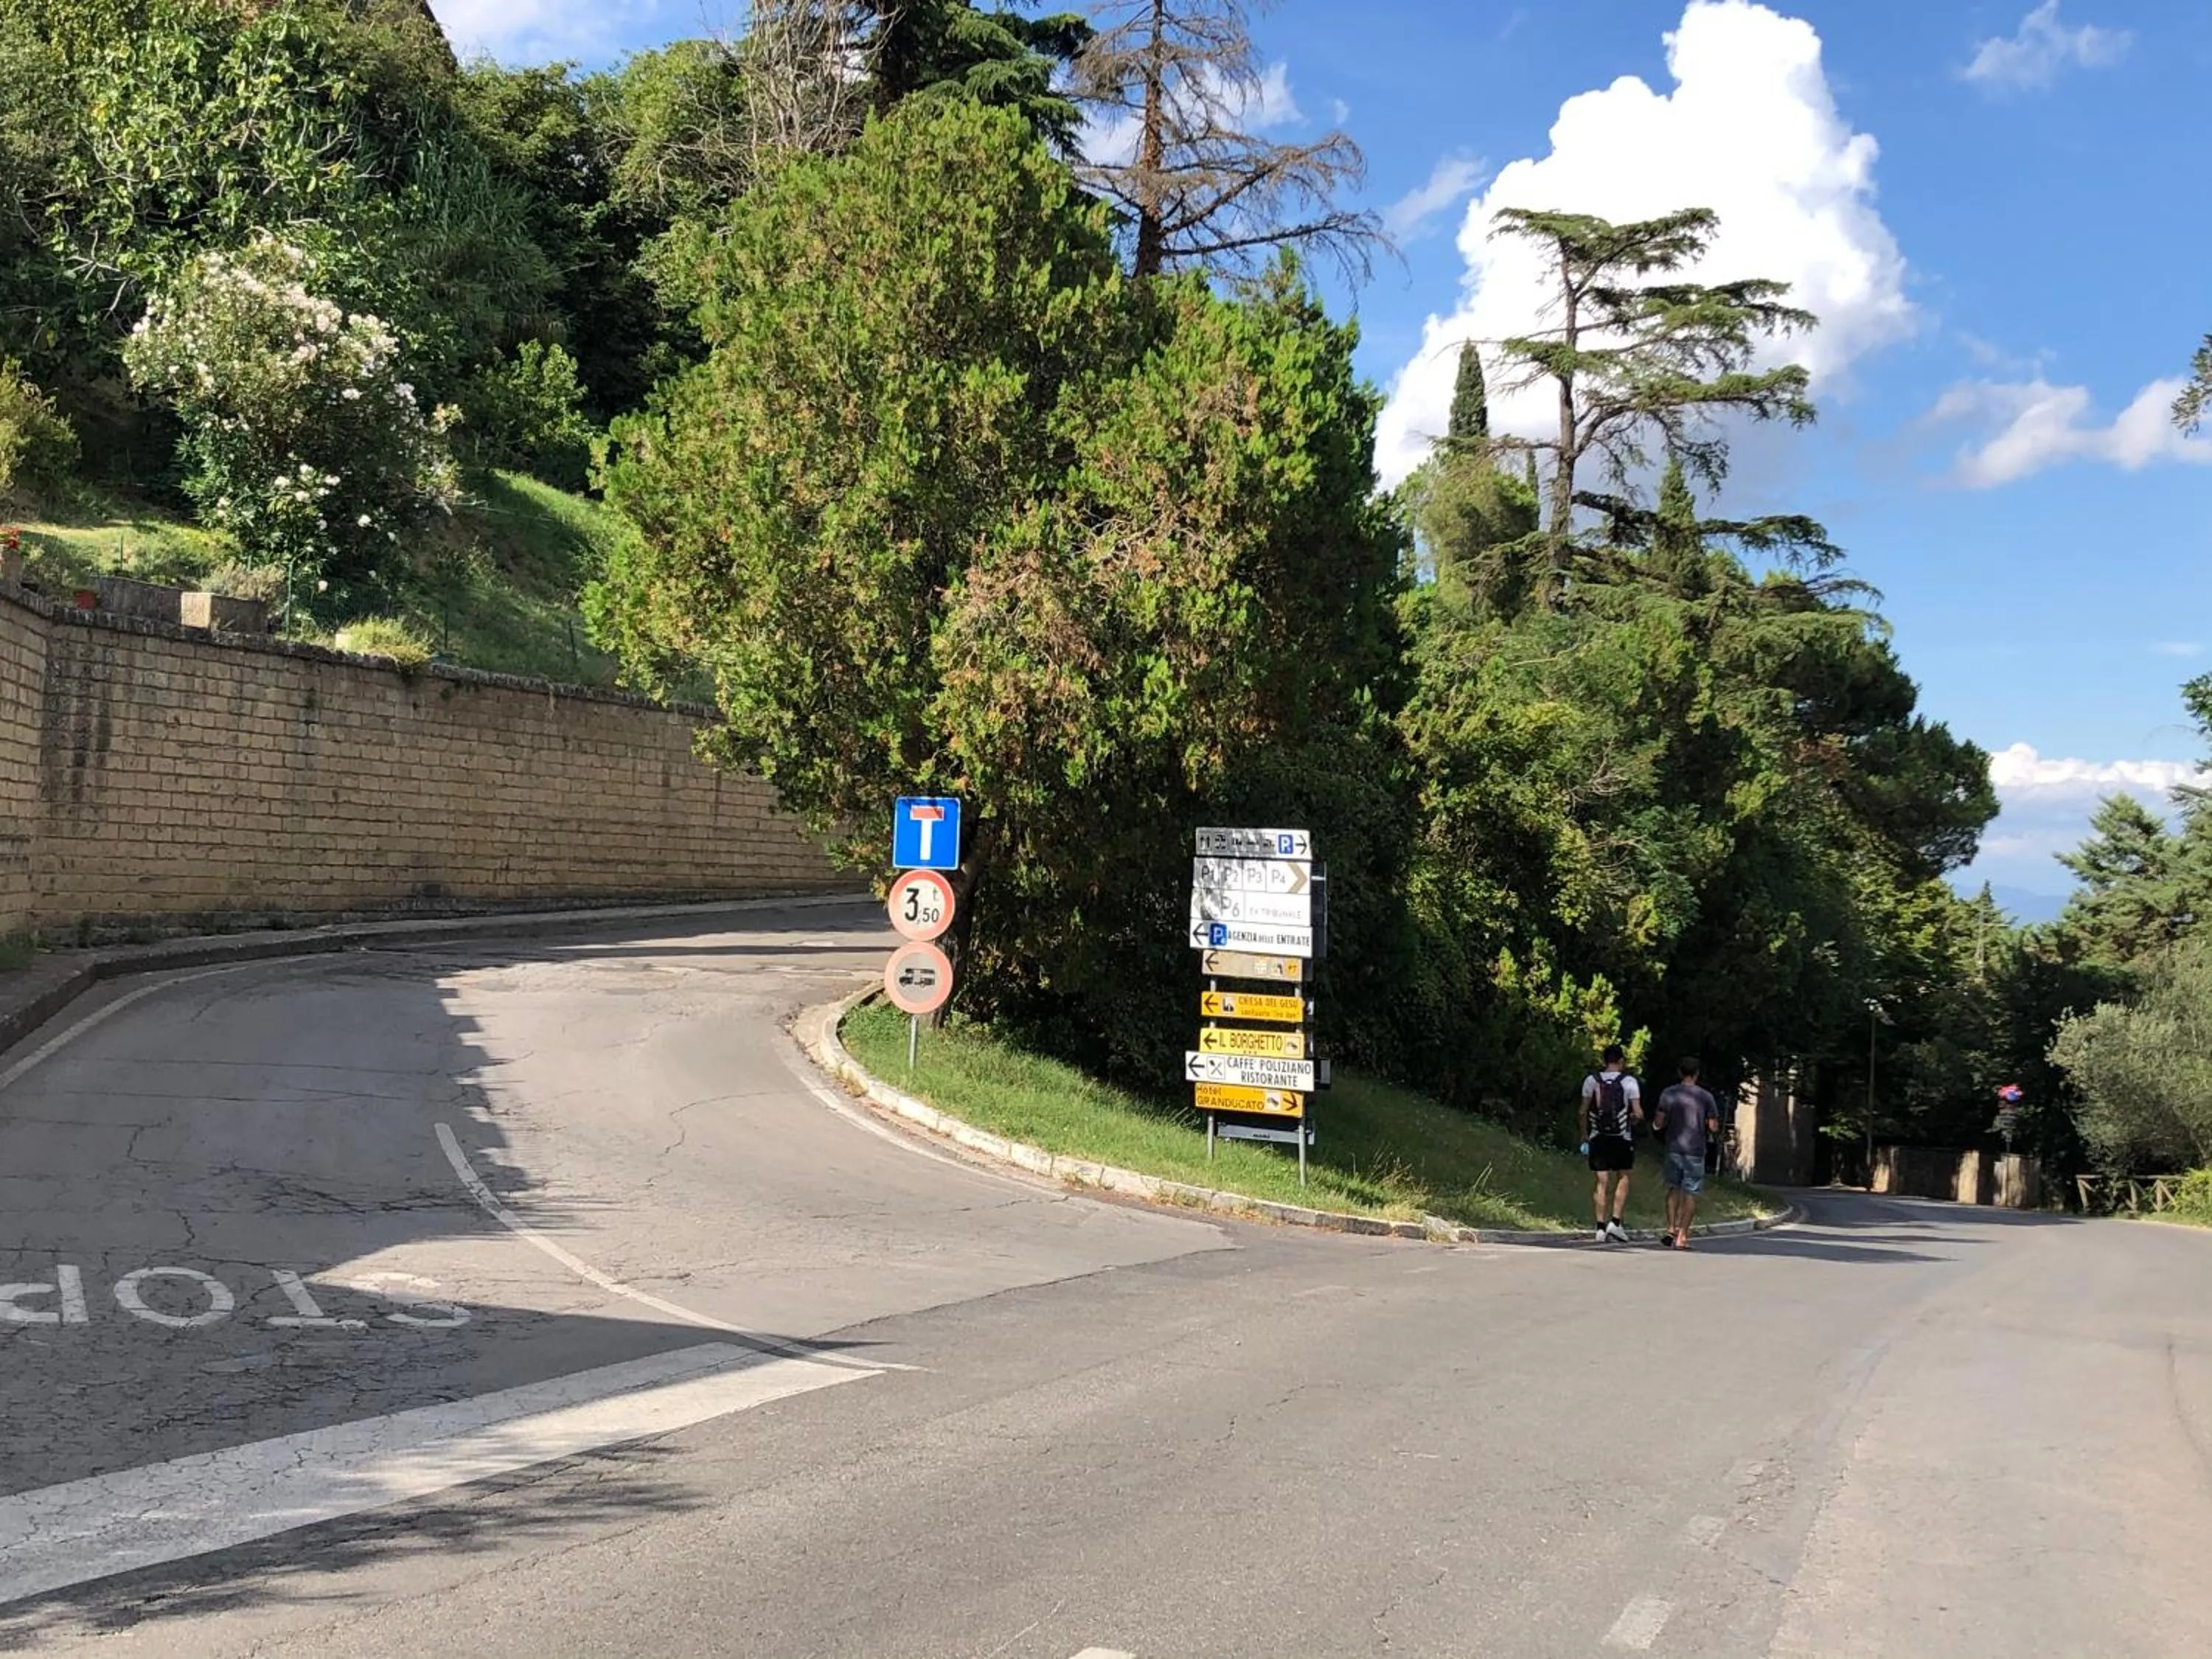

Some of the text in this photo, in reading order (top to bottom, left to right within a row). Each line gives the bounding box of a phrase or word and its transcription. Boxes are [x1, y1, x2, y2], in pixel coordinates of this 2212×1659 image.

[1248, 868, 1263, 883] P3
[1271, 869, 1286, 884] P4
[1228, 929, 1257, 943] AGENZIA
[1276, 934, 1310, 947] ENTRATE
[1219, 1032, 1283, 1051] IL BORGHETTO
[1259, 1060, 1312, 1075] POLIZIANO
[1241, 1071, 1298, 1088] RISTORANTE
[1197, 1085, 1222, 1096] Hotel
[1197, 1095, 1265, 1110] GRANDUCATO
[0, 1264, 472, 1329] STOP
